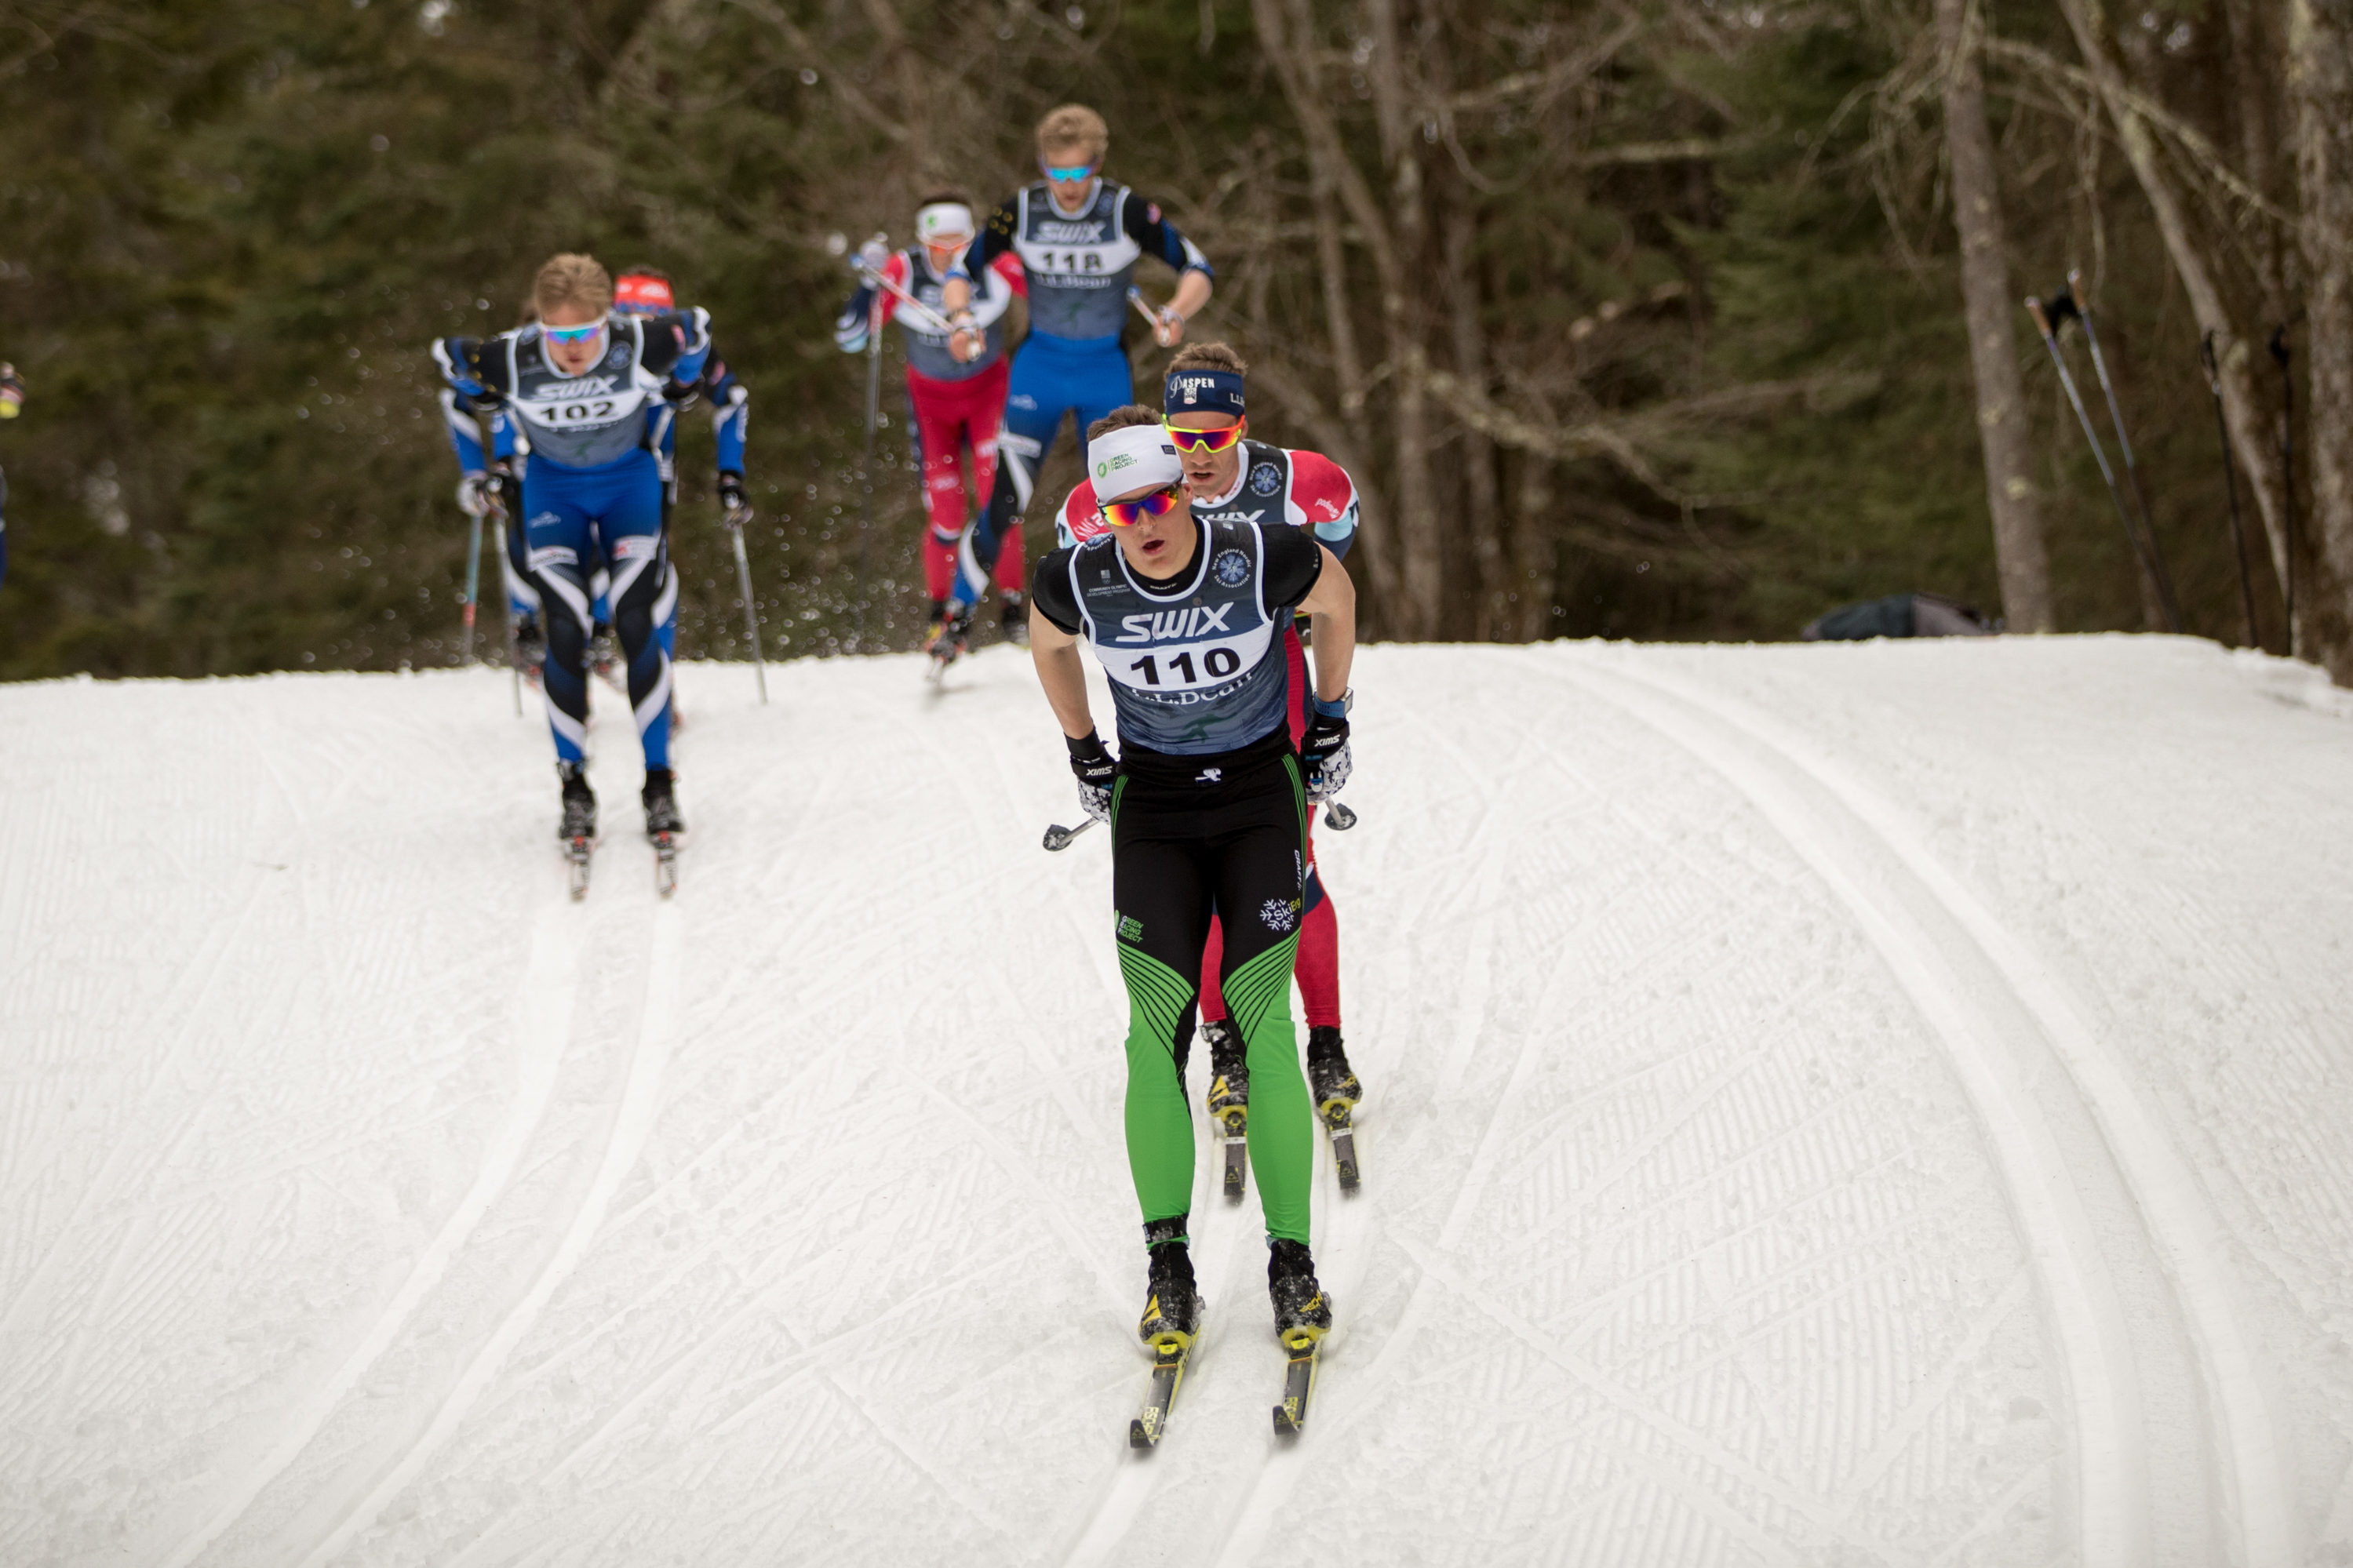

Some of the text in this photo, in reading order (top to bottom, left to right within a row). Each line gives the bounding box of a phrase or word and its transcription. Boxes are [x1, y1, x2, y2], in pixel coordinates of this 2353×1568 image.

[1043, 252, 1102, 273] 118
[532, 374, 619, 402] SWIX
[1182, 377, 1215, 388] ASPEN
[540, 401, 617, 422] 102
[1217, 548, 1240, 558] England
[1239, 550, 1252, 568] Nordic
[1214, 573, 1251, 588] Ski Association
[1115, 602, 1234, 642] SWIX
[1131, 647, 1241, 685] 110
[1314, 734, 1340, 747] SWIX
[1086, 766, 1113, 776] SWIX
[1120, 921, 1142, 935] RACING
[1122, 915, 1144, 930] GREEN
[1117, 927, 1143, 943] PROJECT
